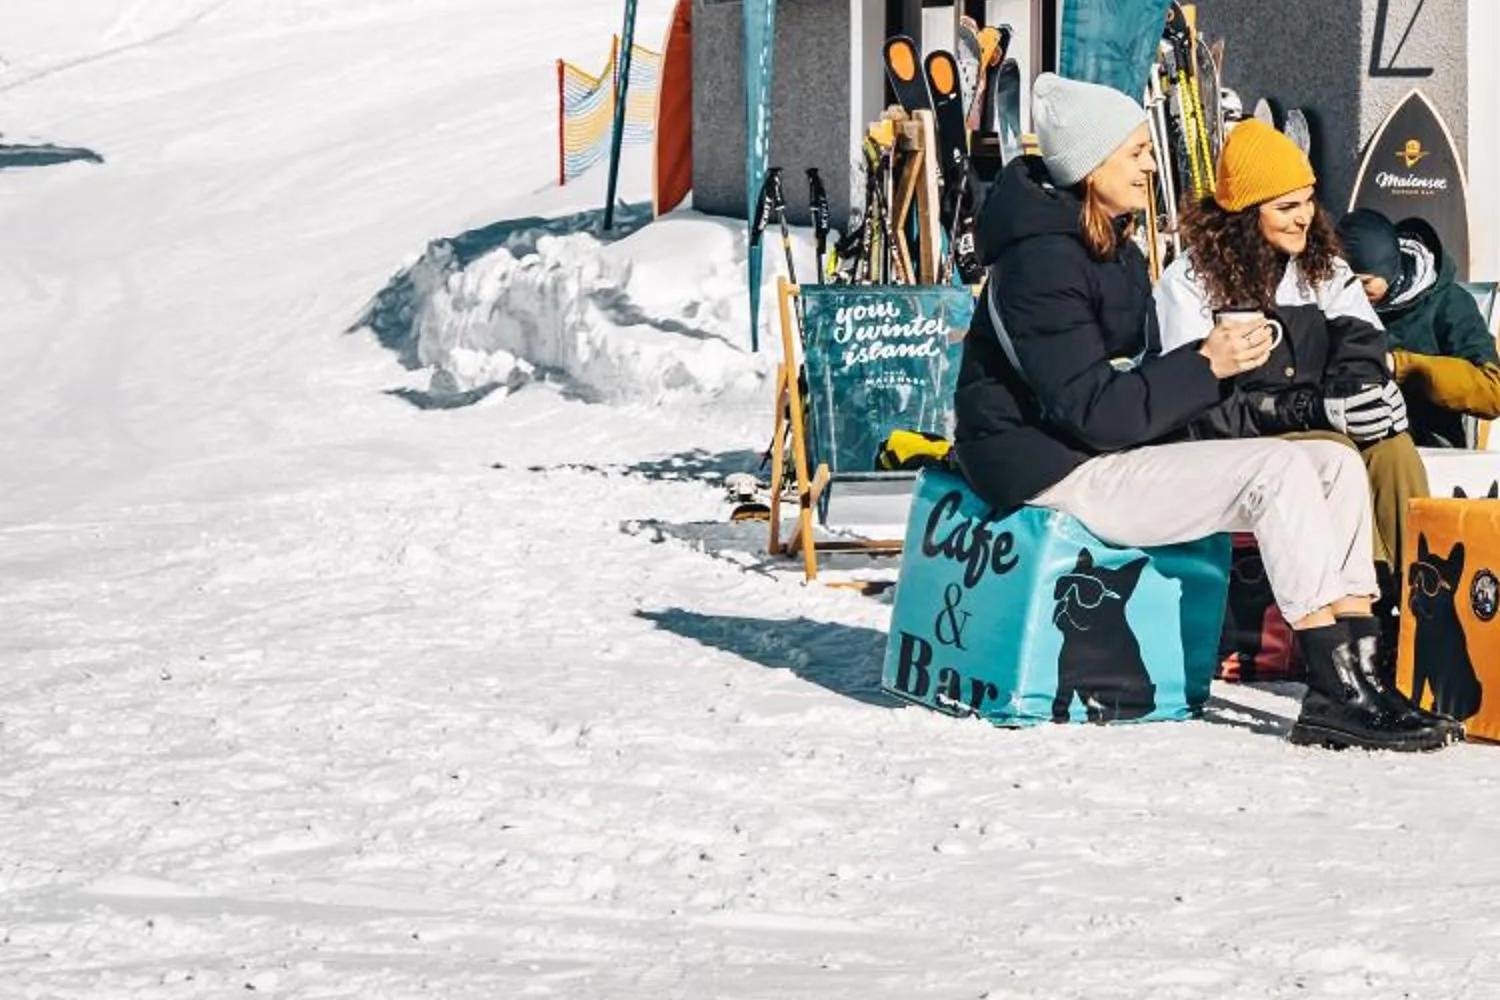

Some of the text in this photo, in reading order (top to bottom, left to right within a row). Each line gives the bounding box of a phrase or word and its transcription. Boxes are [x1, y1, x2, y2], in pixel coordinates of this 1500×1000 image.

[840, 338, 940, 373] island
[855, 313, 950, 341] winter
[922, 490, 1020, 589] Cafe
[935, 582, 973, 651] &
[894, 630, 999, 715] Bar
